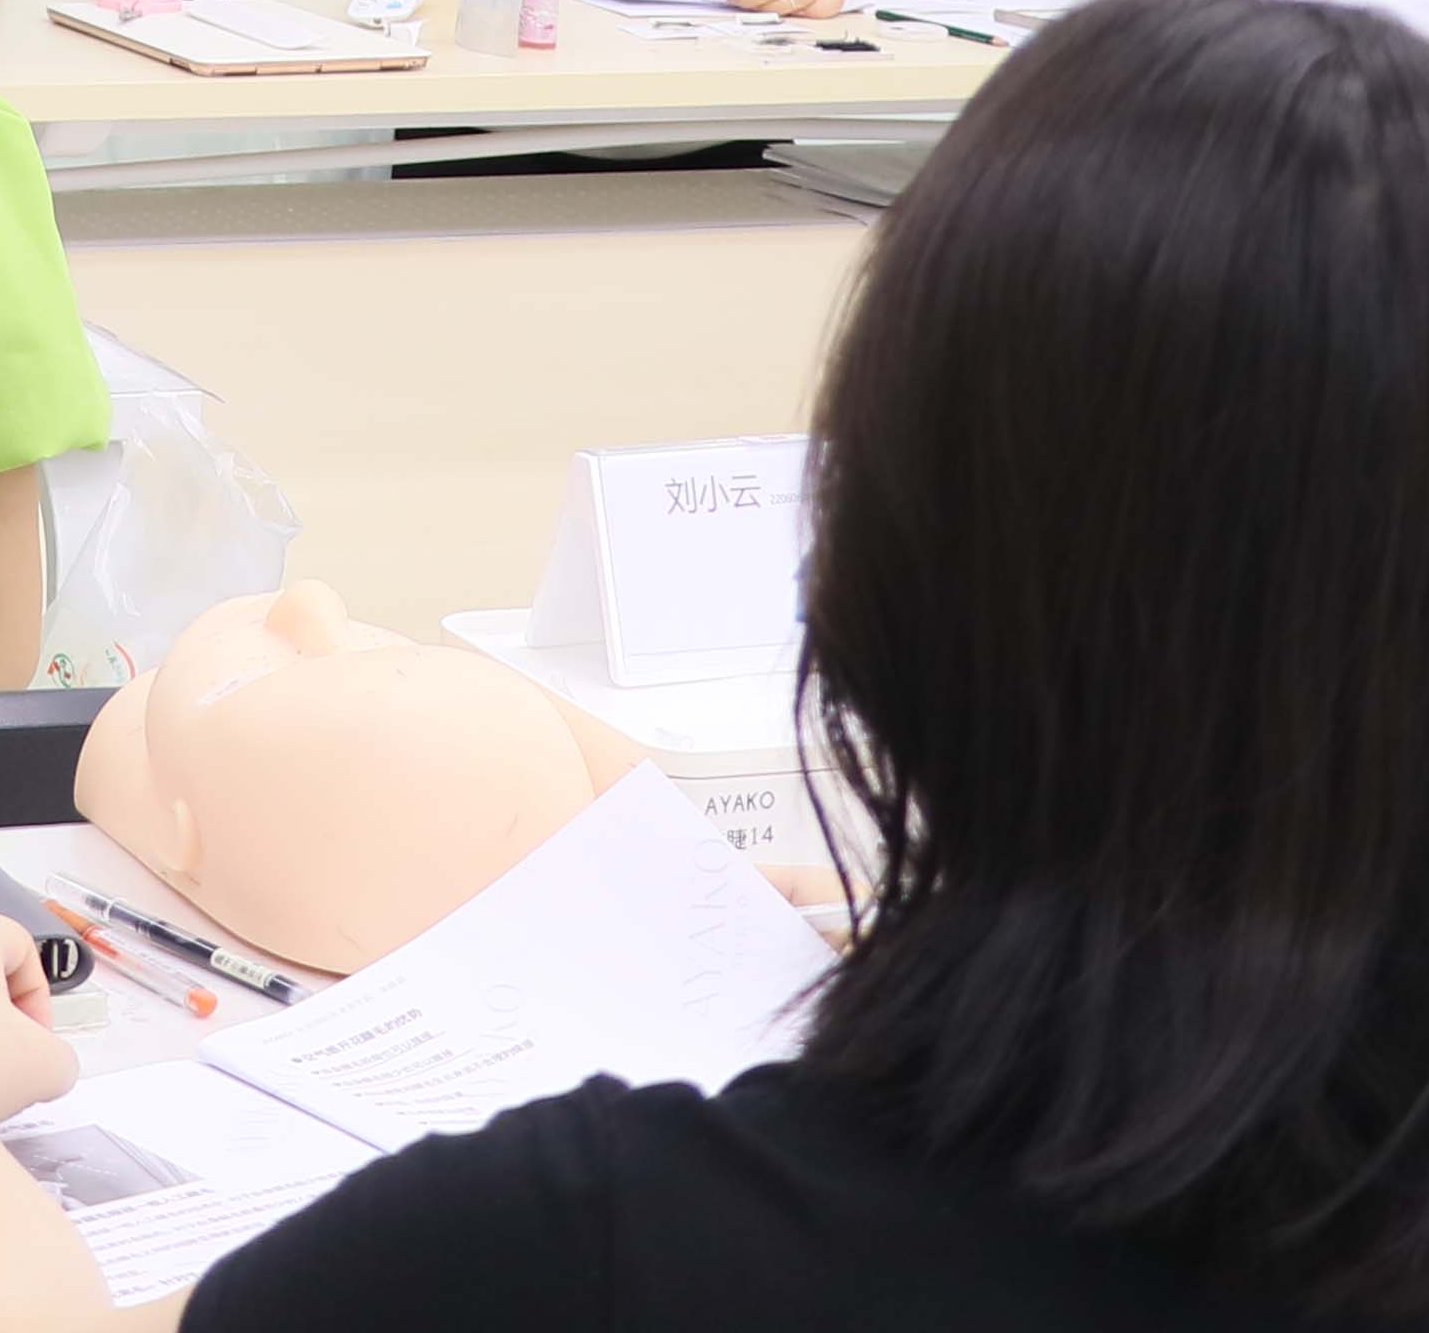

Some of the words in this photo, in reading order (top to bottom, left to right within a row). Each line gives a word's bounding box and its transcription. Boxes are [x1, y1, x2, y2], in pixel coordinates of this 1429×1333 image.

[664, 474, 762, 515] 刘小云
[704, 790, 776, 816] AYAKO
[723, 825, 775, 851] 睫14
